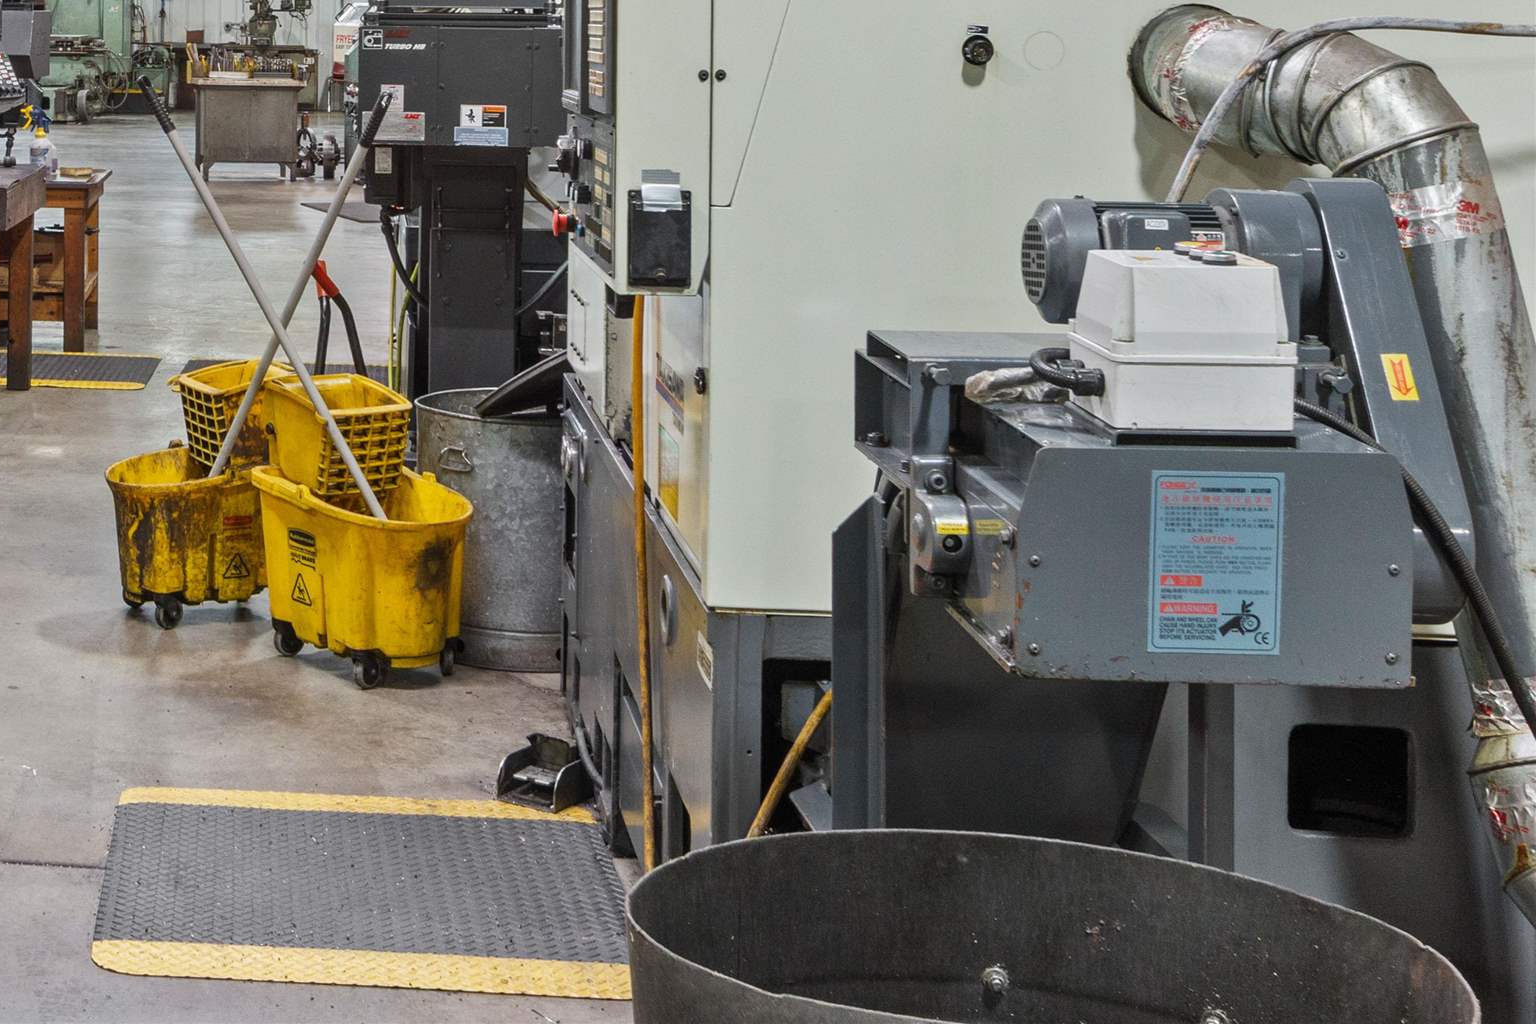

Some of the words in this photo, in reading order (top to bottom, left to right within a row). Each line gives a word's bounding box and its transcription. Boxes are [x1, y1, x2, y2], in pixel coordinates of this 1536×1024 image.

[1457, 199, 1480, 214] 3M
[1191, 536, 1235, 544] CAUTION
[1172, 604, 1215, 614] WARNING
